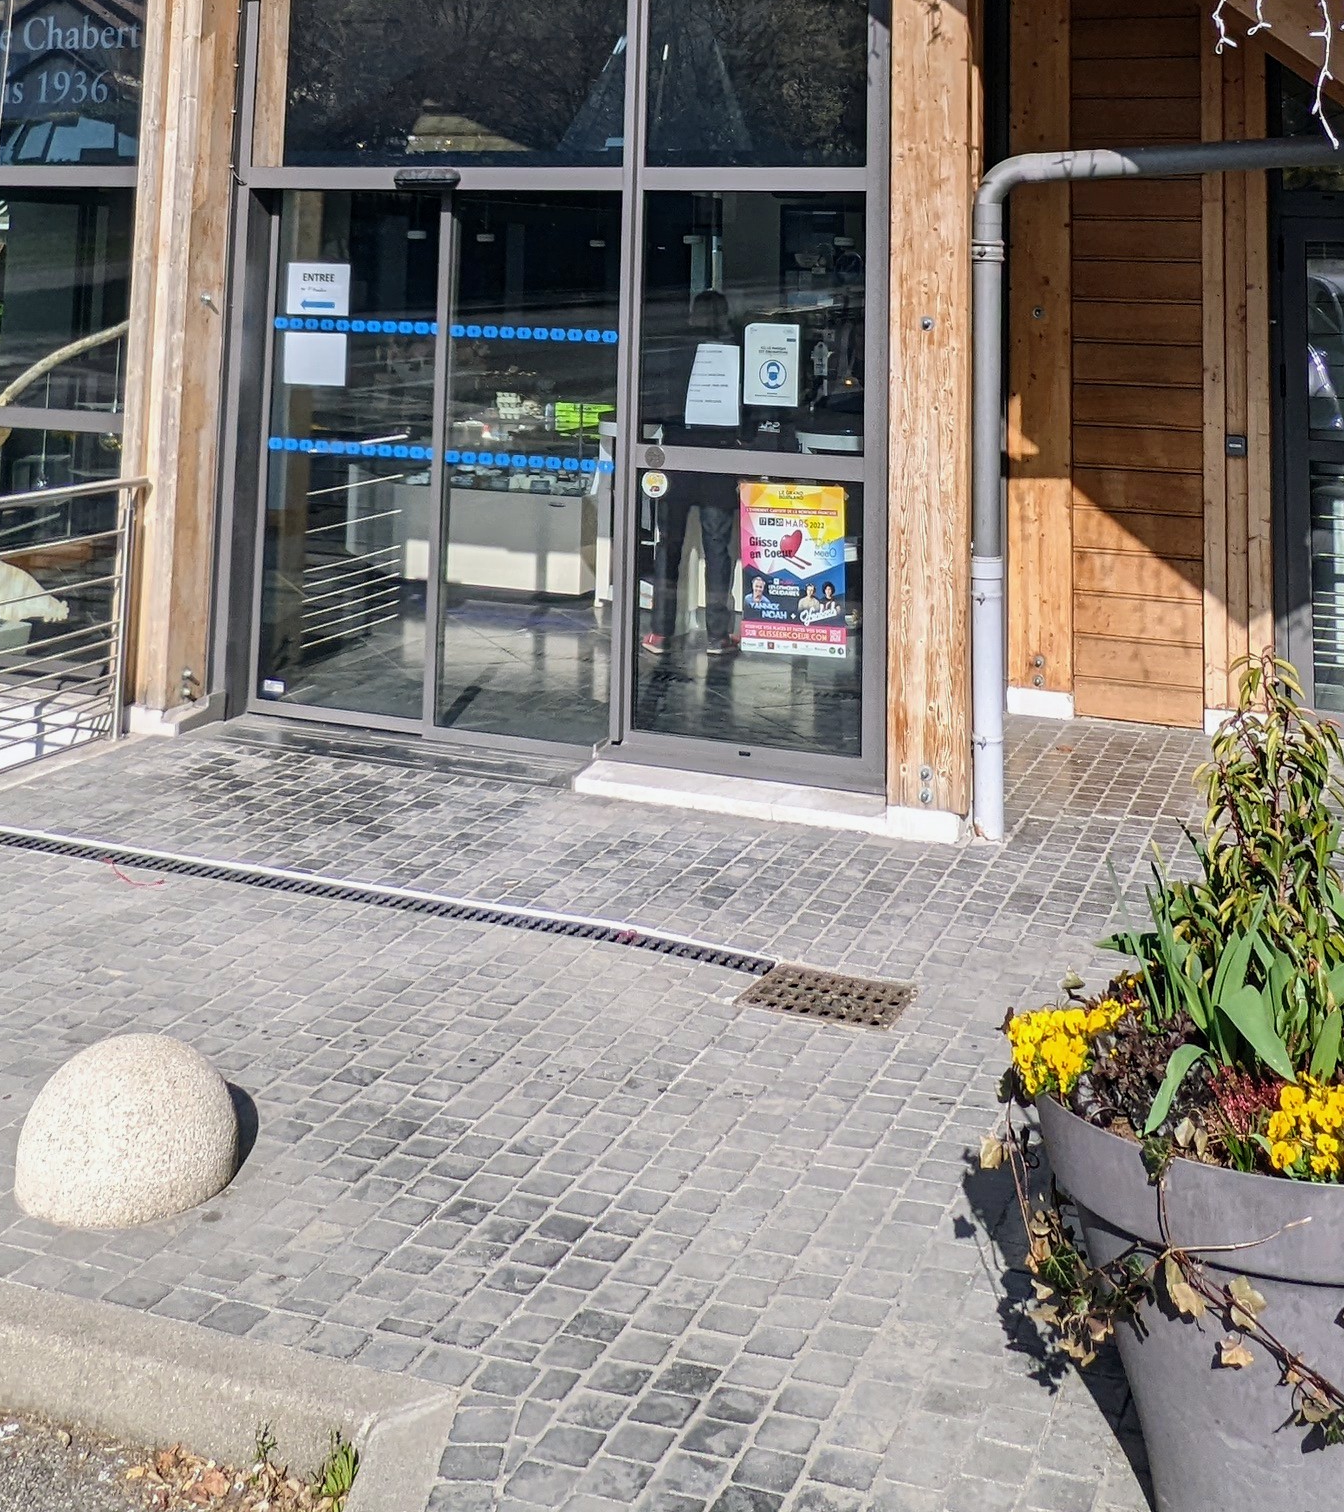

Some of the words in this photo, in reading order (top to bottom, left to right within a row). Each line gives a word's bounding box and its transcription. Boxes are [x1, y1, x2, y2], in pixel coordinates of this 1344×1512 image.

[23, 15, 140, 51] Chabert
[38, 70, 109, 104] 1936
[302, 272, 336, 283] ENTREE
[785, 519, 809, 528] MARS
[749, 536, 778, 548] Glisse
[749, 550, 762, 559] en
[764, 548, 793, 559] Coeur
[762, 610, 787, 620] NOAH
